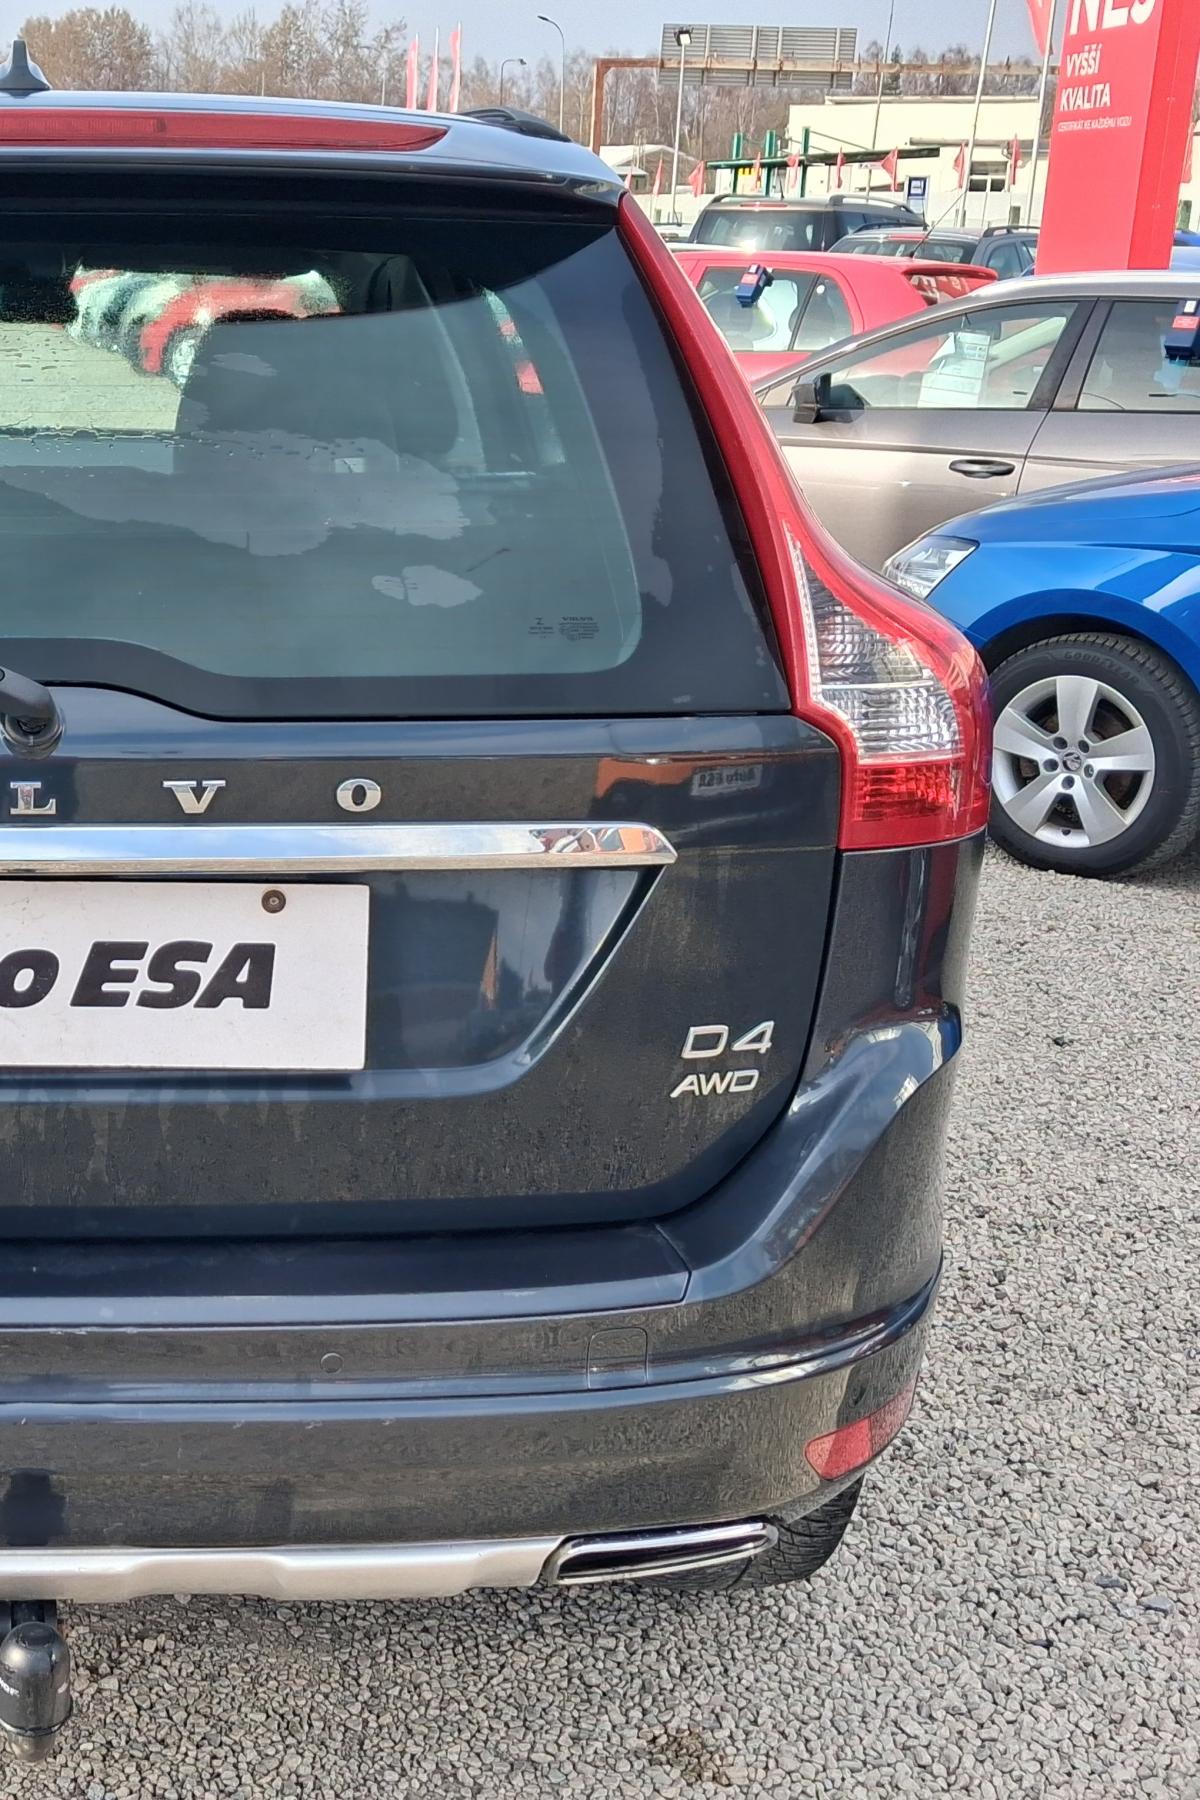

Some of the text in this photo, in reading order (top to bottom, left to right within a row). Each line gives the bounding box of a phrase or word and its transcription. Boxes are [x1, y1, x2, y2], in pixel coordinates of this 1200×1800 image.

[1066, 43, 1103, 78] VYŠŠÍ
[1060, 82, 1111, 112] KVALITA
[69, 940, 277, 1010] ESA
[681, 1020, 775, 1059] D4
[669, 1069, 759, 1098] AWD
